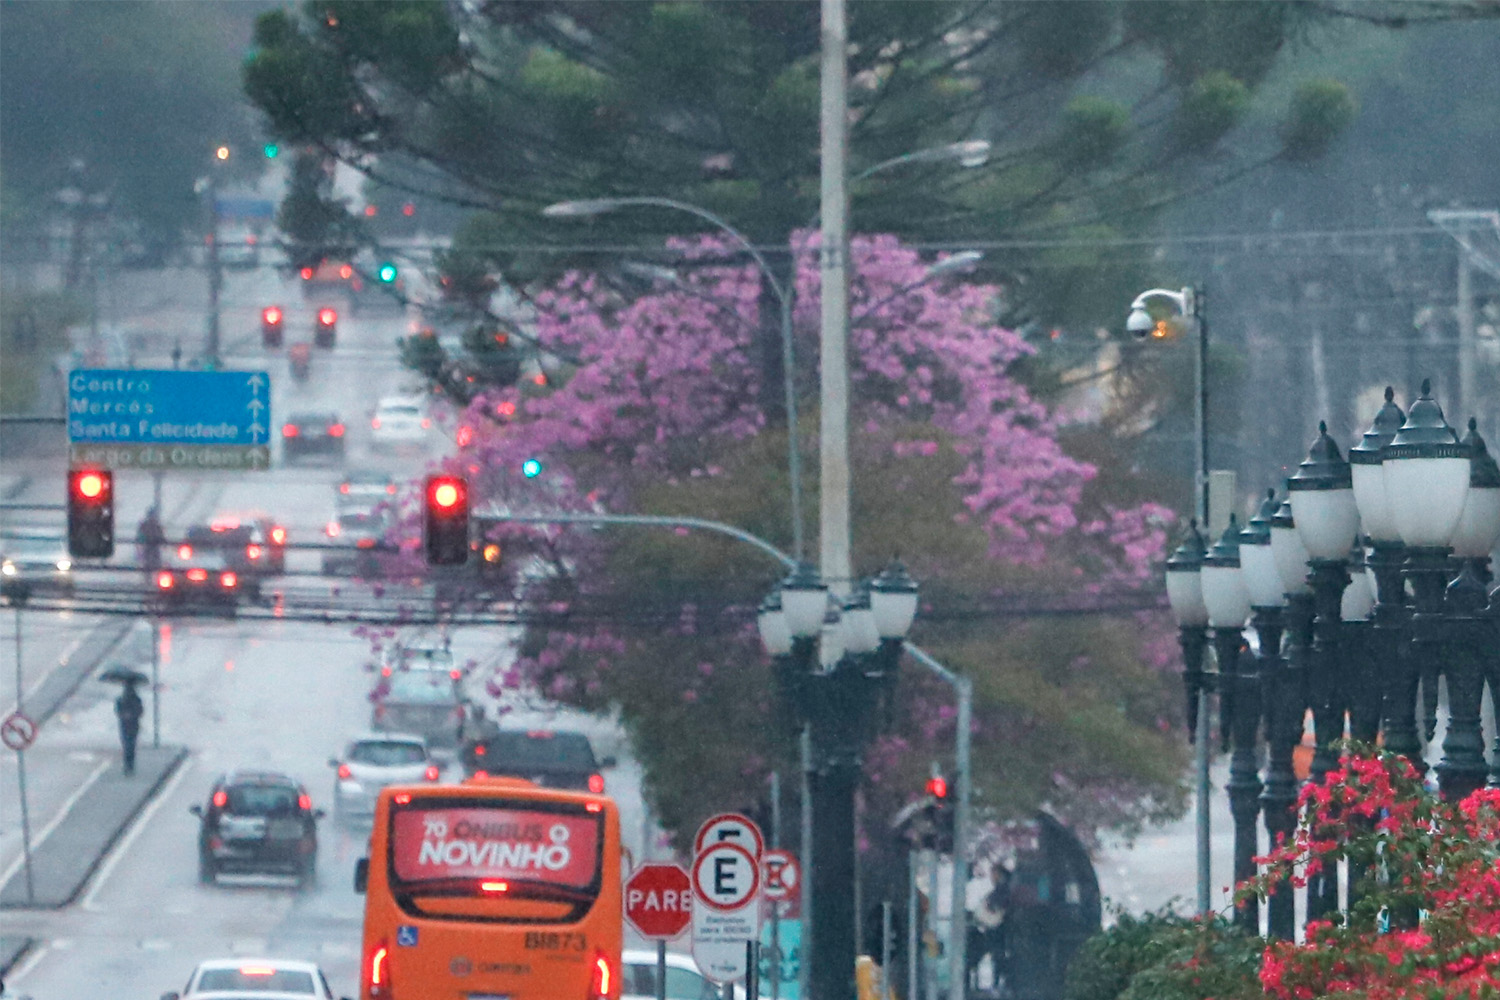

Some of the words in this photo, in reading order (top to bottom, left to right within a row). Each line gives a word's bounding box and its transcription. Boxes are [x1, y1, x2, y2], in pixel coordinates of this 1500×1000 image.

[72, 375, 150, 392] Centro
[72, 420, 131, 437] Santa
[139, 420, 238, 438] Felicidade
[418, 839, 571, 871] NOVINHO
[714, 857, 738, 895] E
[628, 889, 693, 912] PARE
